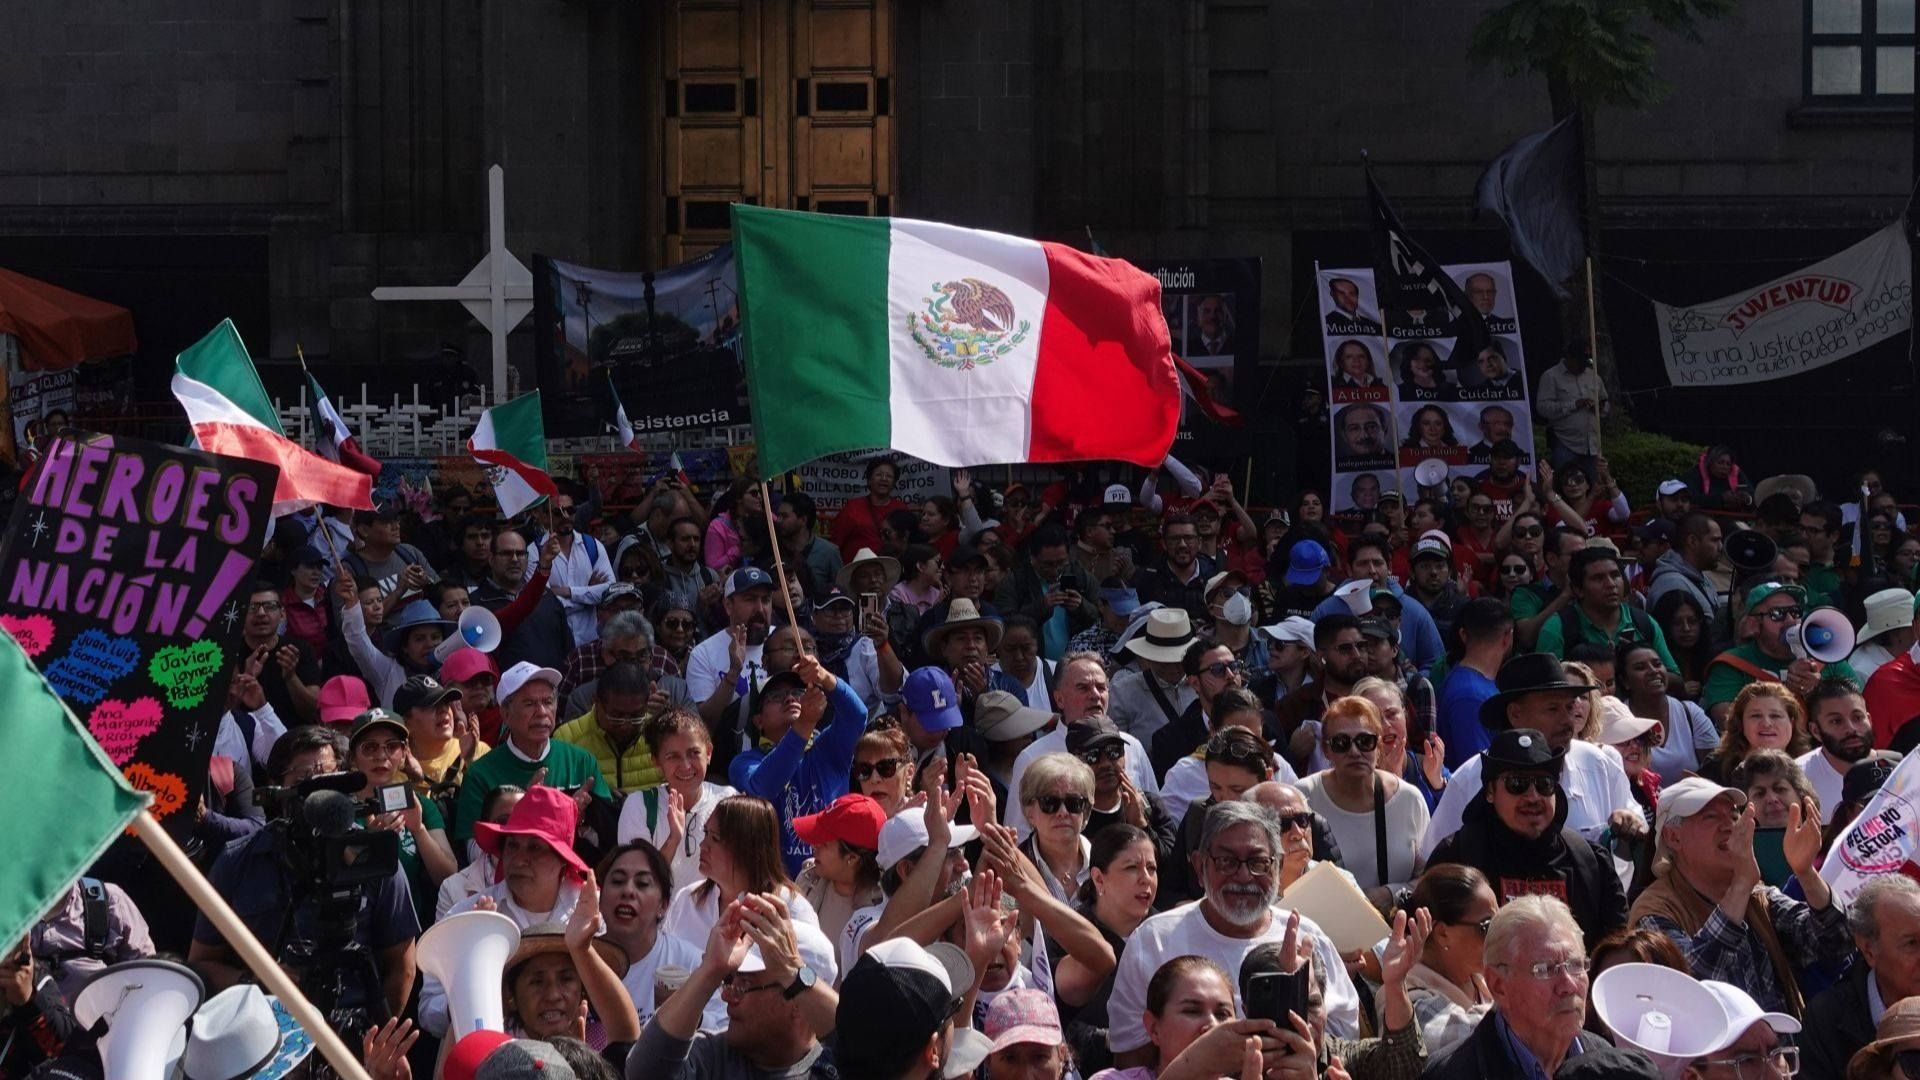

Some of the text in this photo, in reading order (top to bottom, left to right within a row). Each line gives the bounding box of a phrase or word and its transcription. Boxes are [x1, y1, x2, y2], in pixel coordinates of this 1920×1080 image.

[1727, 277, 1852, 330] JUVENTUD
[1327, 320, 1377, 335] Muchas
[1392, 325, 1443, 338] Gracias
[1671, 341, 1700, 367] Por
[1706, 347, 1742, 363] una
[1816, 311, 1857, 340] para
[1863, 280, 1912, 316] todos
[1680, 366, 1708, 384] NO
[1711, 365, 1748, 380] para
[1801, 334, 1848, 365] pueda
[1338, 390, 1381, 401] A ti no
[1415, 387, 1440, 400] Por
[1458, 386, 1519, 401] Cuidar la
[823, 468, 859, 480] ROBO
[30, 435, 259, 545] HÉROES
[55, 518, 199, 574] DE LA
[78, 636, 136, 663] Juan Luis
[159, 649, 215, 672] Javier
[931, 689, 947, 709] L
[97, 710, 122, 721] Ana
[786, 845, 814, 856] JALI
[1857, 822, 1907, 859] SETOCA
